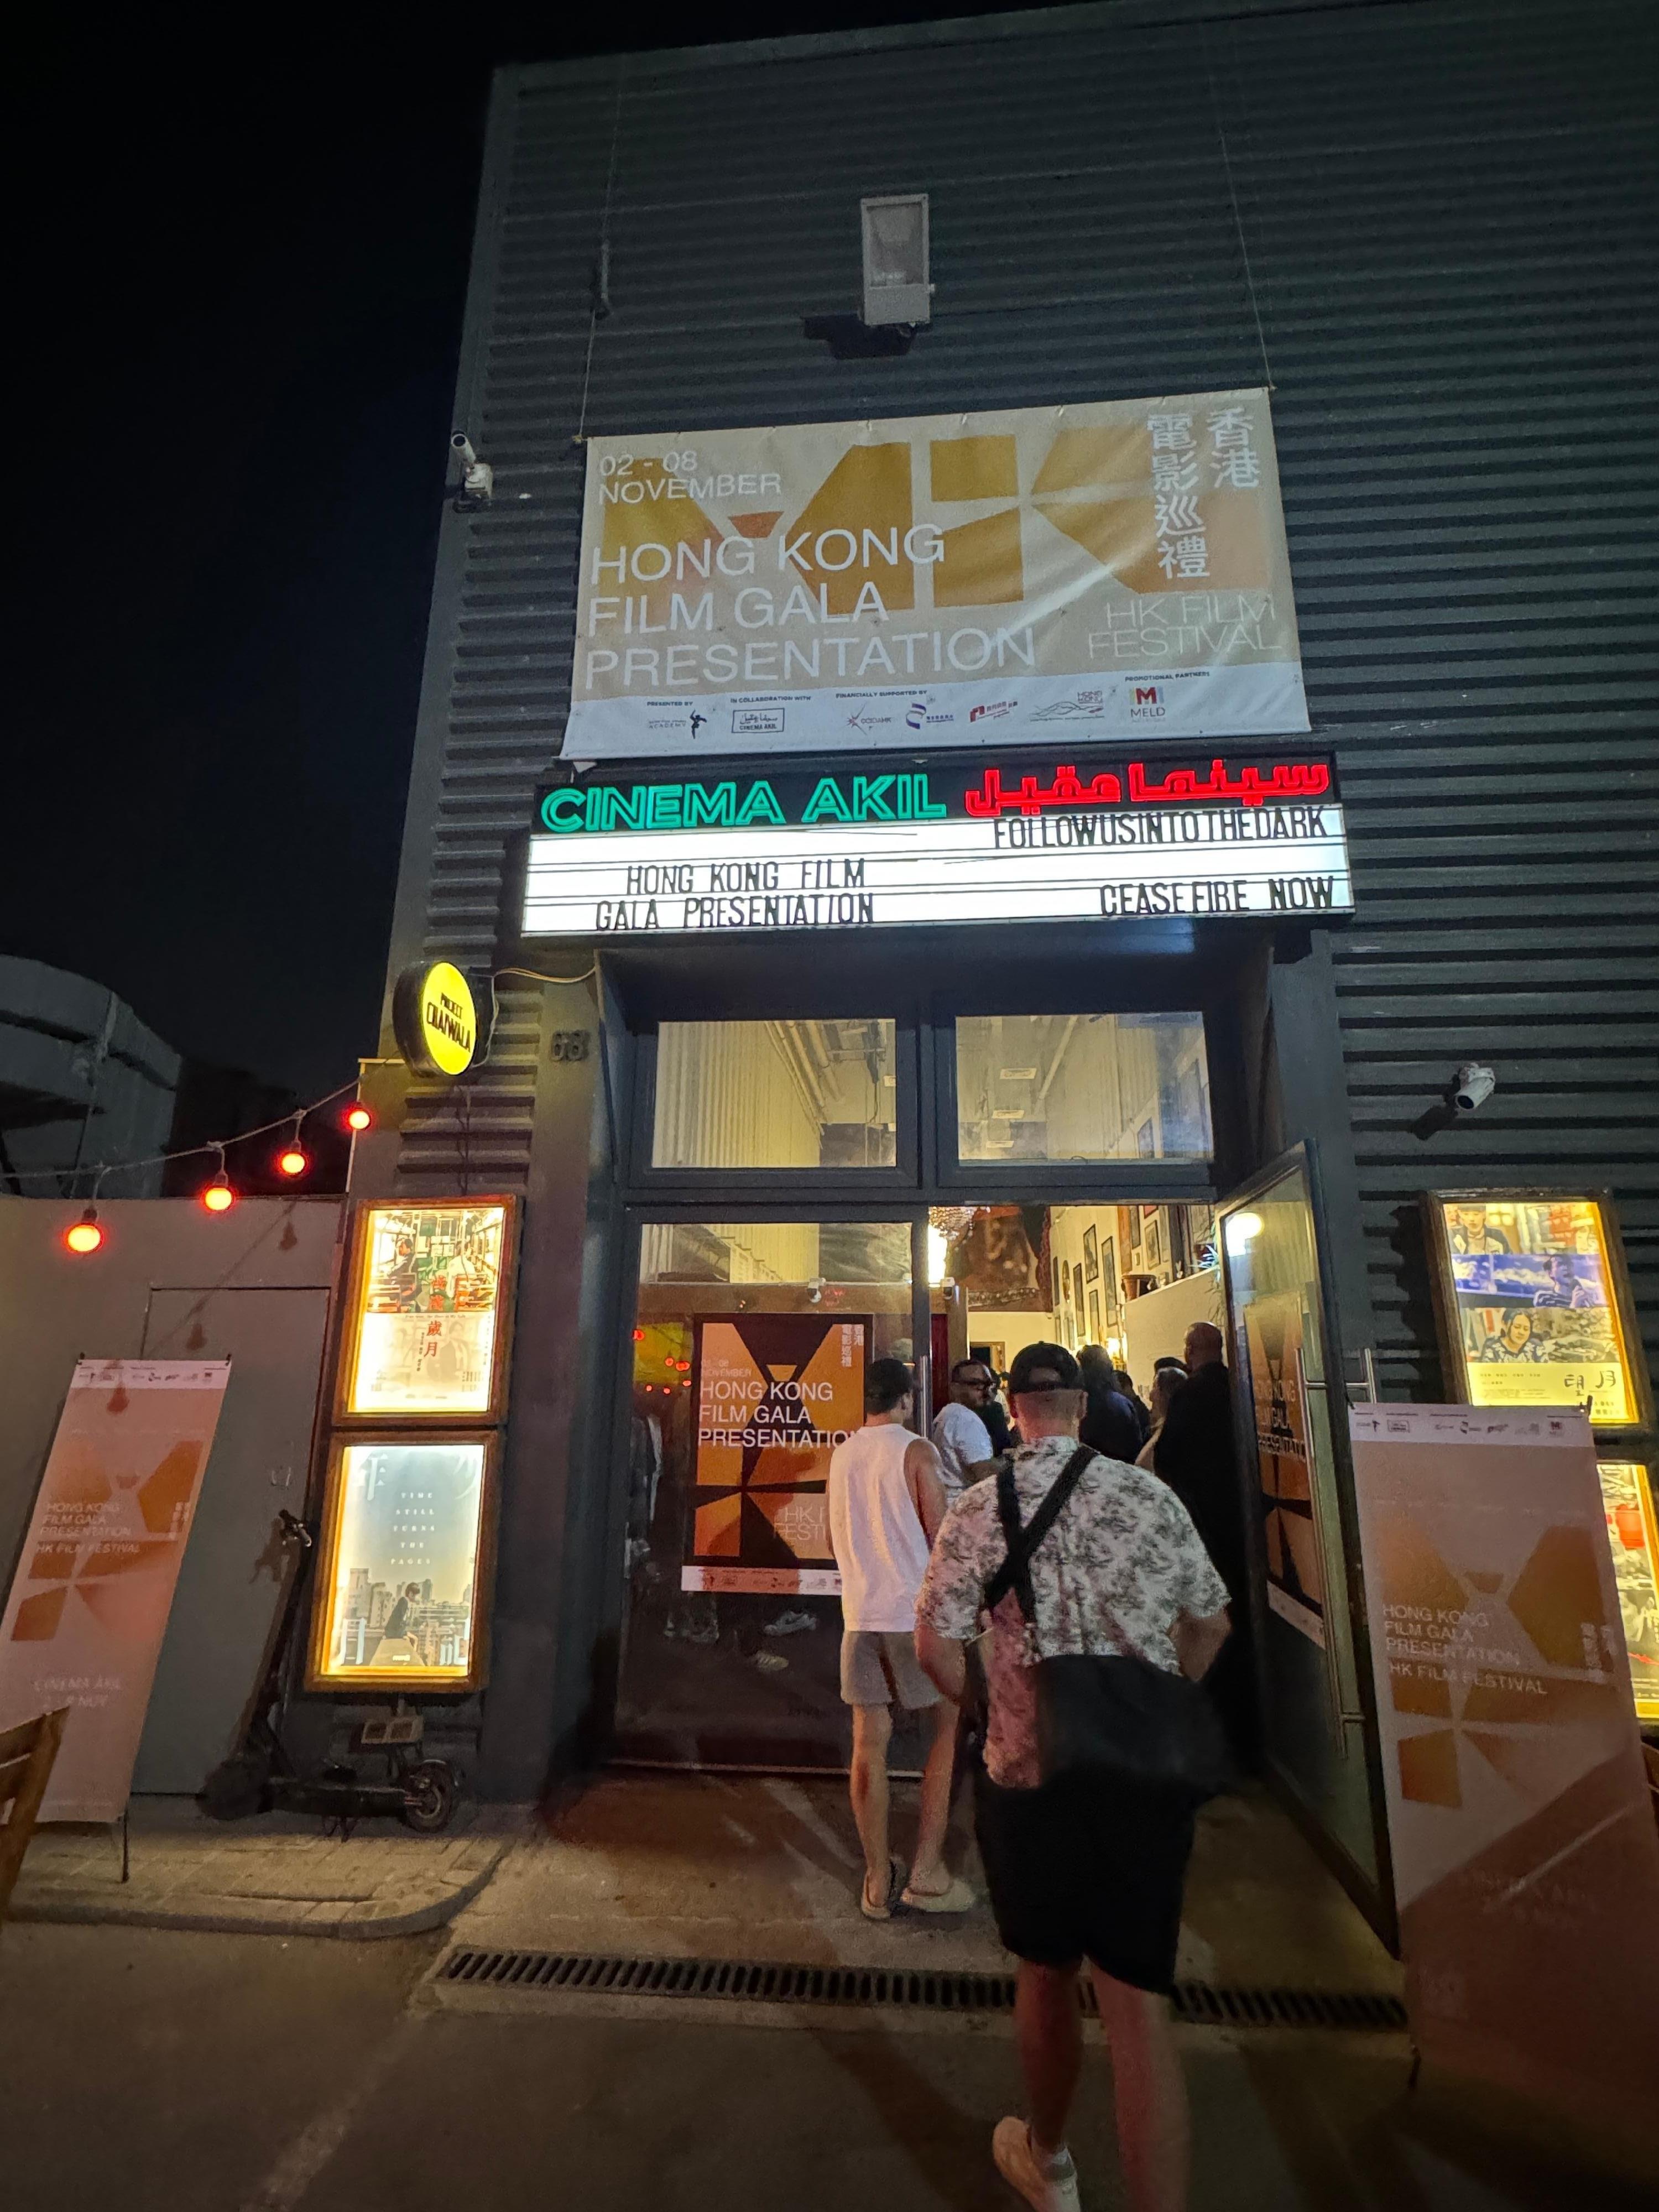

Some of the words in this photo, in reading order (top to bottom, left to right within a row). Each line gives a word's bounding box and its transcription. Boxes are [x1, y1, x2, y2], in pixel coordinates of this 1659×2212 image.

[599, 454, 634, 477] 02
[662, 450, 698, 473] 08
[1206, 405, 1261, 488] 香港
[598, 472, 781, 505] NOVEMBER
[1146, 413, 1210, 580] 電影巡禮
[591, 537, 755, 586] HONG
[778, 523, 945, 572] KONG
[588, 592, 714, 637] FILM
[734, 581, 889, 629] GALA
[1106, 601, 1167, 629] HK
[1182, 594, 1276, 623] FILM
[585, 626, 1035, 690] PRESENTATION
[1088, 624, 1282, 660] FESTIVAL
[1130, 706, 1166, 718] MELD
[1128, 759, 1330, 807] سينما
[540, 780, 786, 832] CINEMA
[801, 773, 947, 822] AKIL
[627, 864, 694, 896] HONG
[710, 861, 779, 893] KONG
[801, 858, 865, 890] FILM
[1268, 875, 1334, 911] NOW
[596, 899, 660, 931] GALA
[683, 893, 874, 928] PRESENTATION
[700, 1380, 763, 1401] HONG
[770, 1382, 833, 1401] KONG
[699, 1405, 747, 1424] FILM
[754, 1405, 811, 1425] GALA
[698, 1427, 855, 1448] PRESENTATIO
[785, 1505, 815, 1523] HK
[1383, 1604, 1433, 1622] HONG
[1384, 1620, 1421, 1636] FILM
[1426, 1624, 1474, 1642] GALA
[1389, 1662, 1412, 1676] HK
